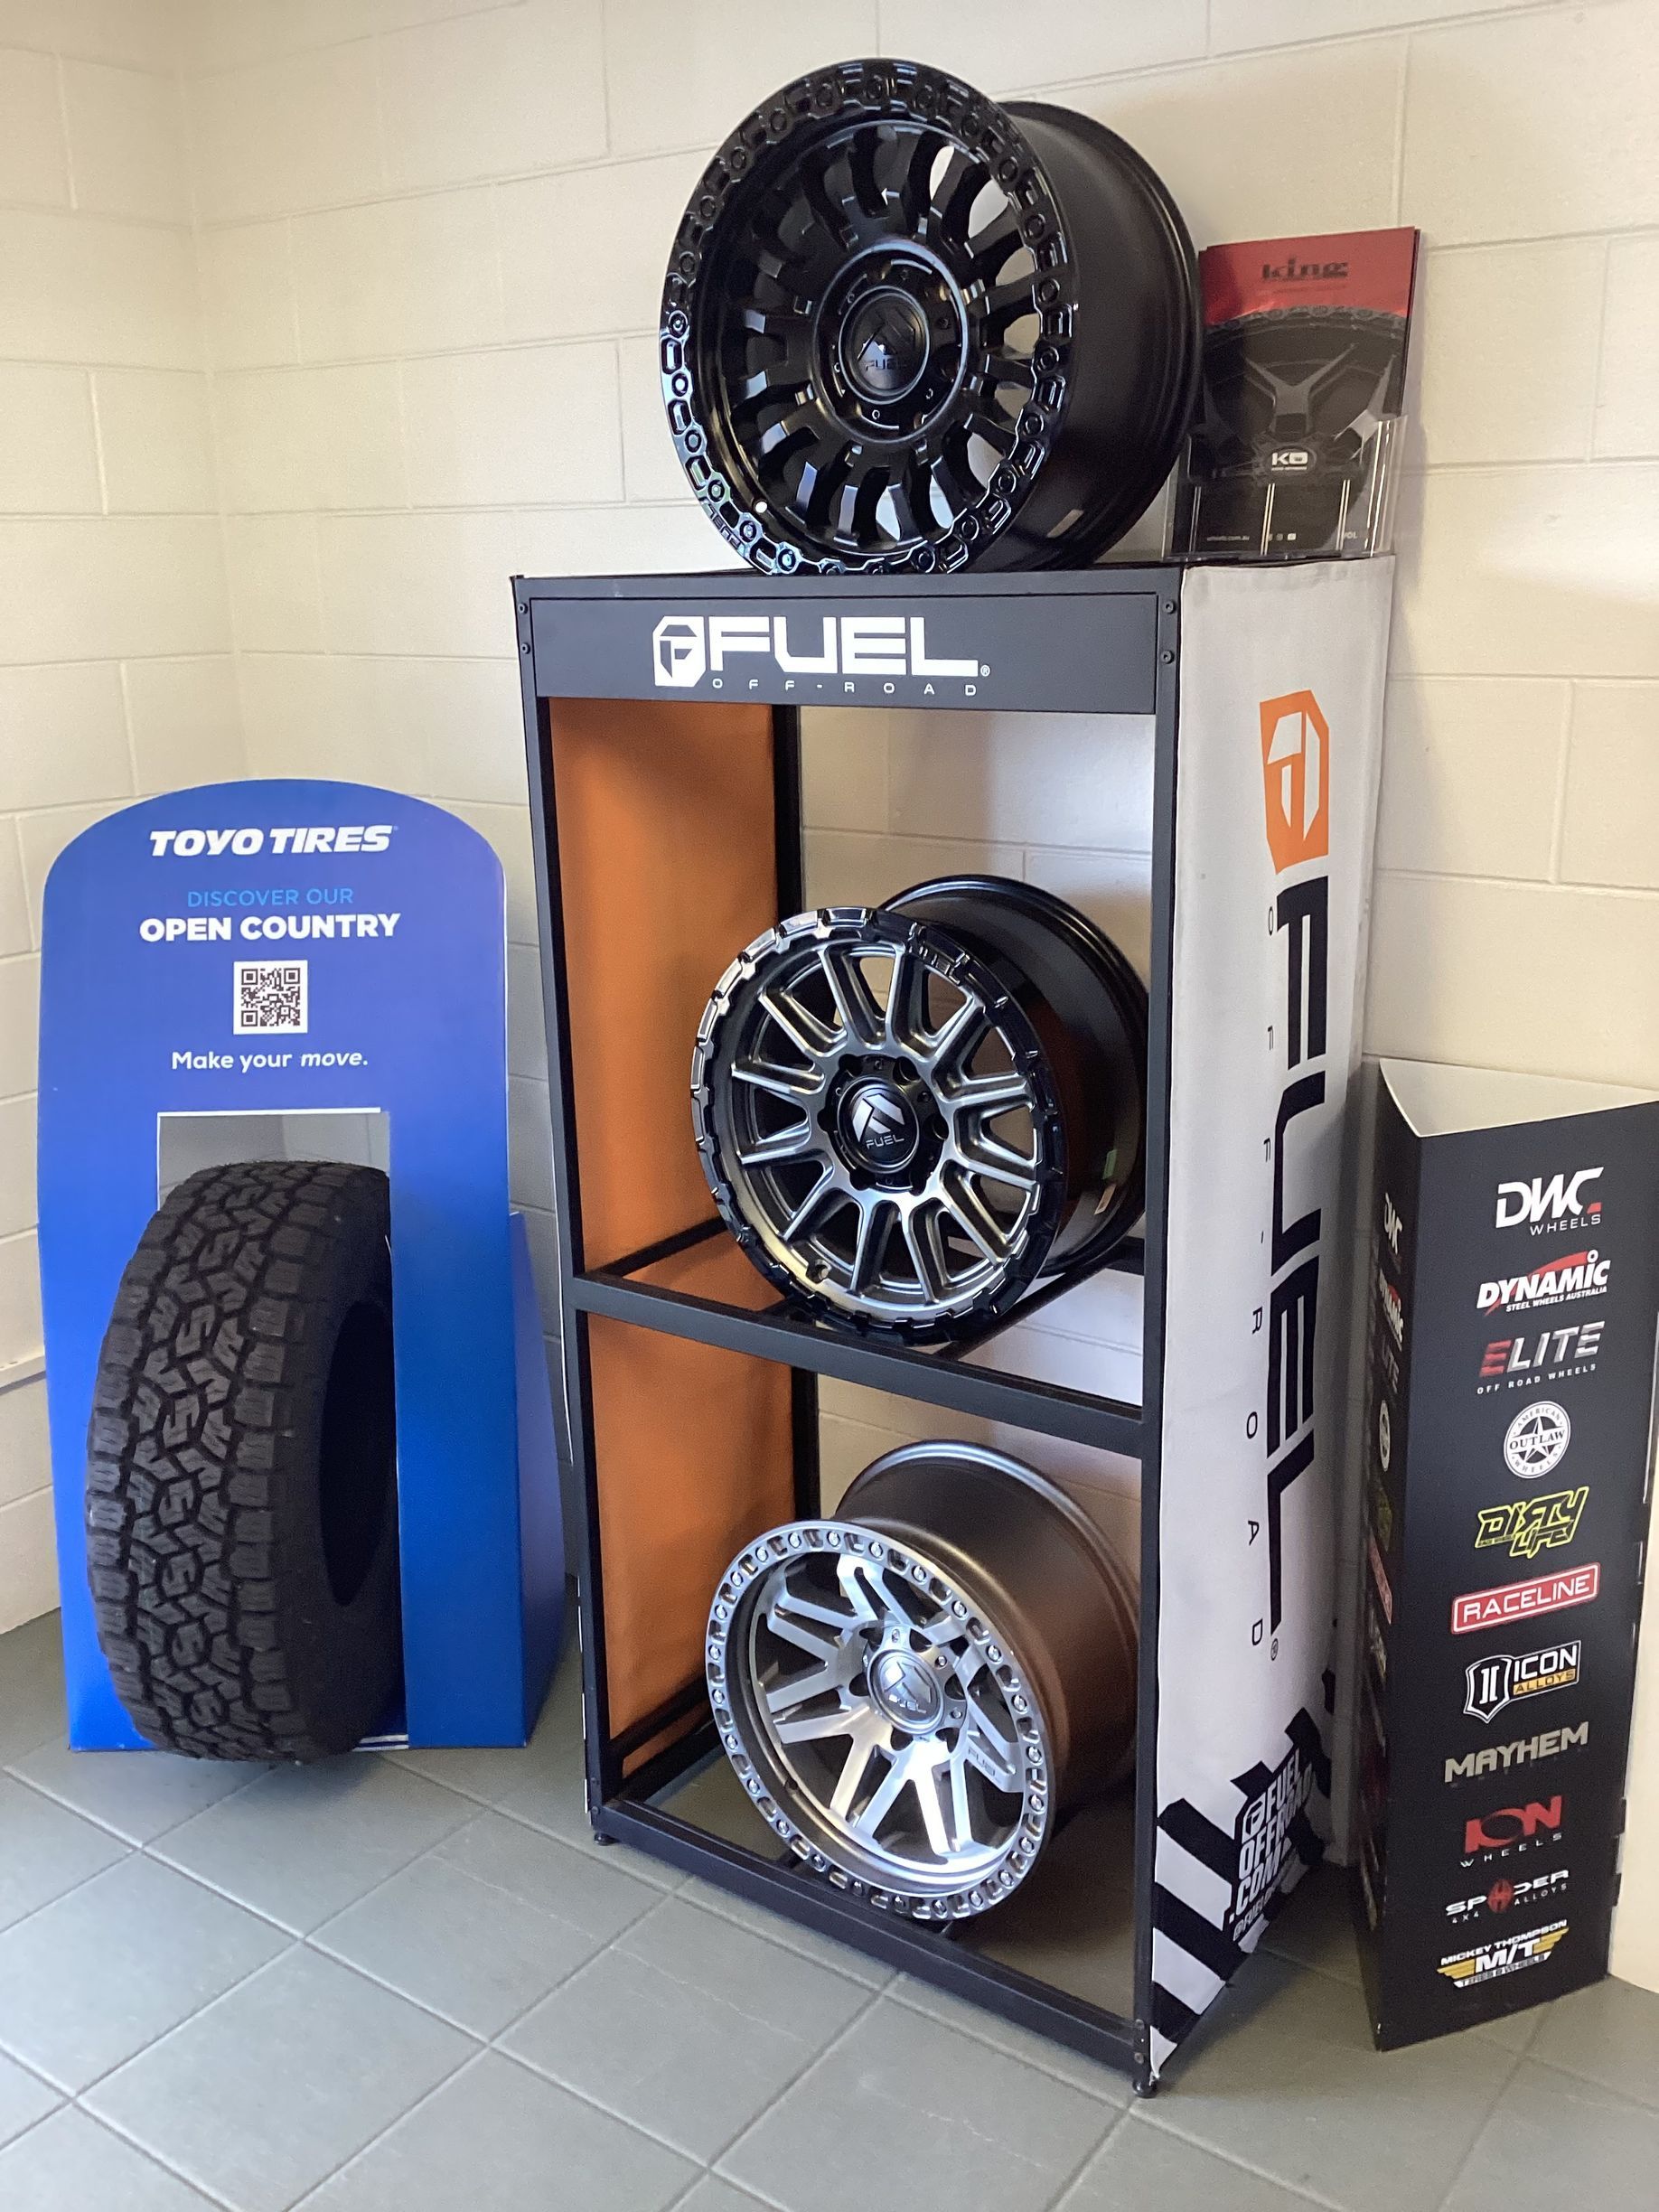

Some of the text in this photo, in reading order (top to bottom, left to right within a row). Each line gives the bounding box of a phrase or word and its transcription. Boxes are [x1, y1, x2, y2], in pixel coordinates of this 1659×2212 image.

[712, 678, 977, 696] OFF-ROAD
[149, 824, 393, 857] TOYO TIRES
[187, 887, 353, 908] DISCOVER OUR
[139, 913, 401, 942] OPEN COUNTRY
[172, 1051, 369, 1073] Make your move.
[866, 1134, 904, 1149] FUEL
[1530, 1214, 1601, 1236] WHEELS
[1505, 1285, 1607, 1312] STEEL WHEELS AUSTRALIA
[1479, 1320, 1605, 1377] ELITE
[1476, 1364, 1596, 1394] OFF ROAD WHEELS
[1517, 1406, 1561, 1429] AMERICAN
[1509, 1429, 1566, 1450] OUTLAW
[1477, 1486, 1589, 1539] DIRTY
[1509, 1521, 1575, 1559] LIFE
[1463, 1573, 1590, 1623] RACELINE
[1514, 1645, 1577, 1682] ICON
[1515, 1669, 1575, 1692] ALLOYS
[1444, 1720, 1589, 1783] MAYHEM
[1465, 1795, 1562, 1853] ION
[1459, 1832, 1562, 1868] WHEELS
[1514, 1882, 1567, 1906] ALLOYS
[1440, 1919, 1567, 1965] MICKEY THOMPSON
[1475, 1938, 1541, 1973] M/T
